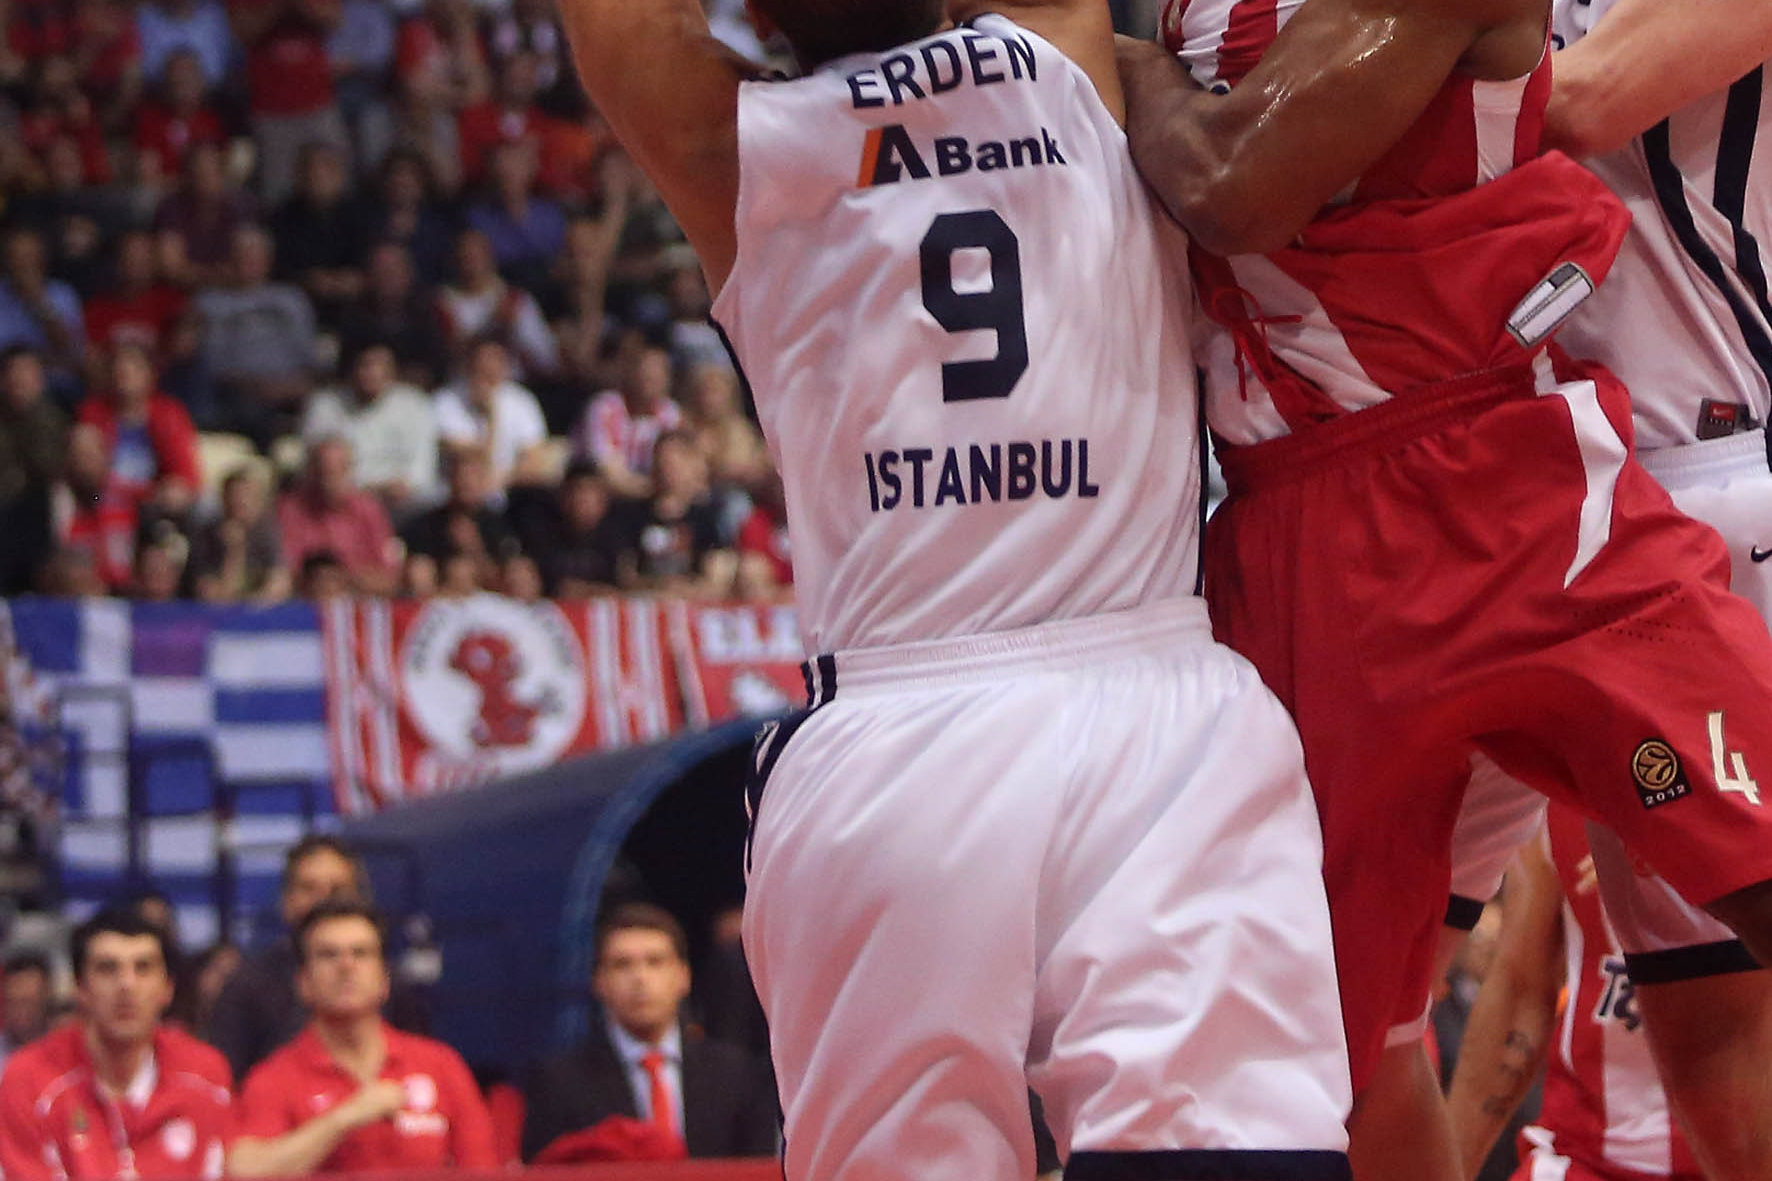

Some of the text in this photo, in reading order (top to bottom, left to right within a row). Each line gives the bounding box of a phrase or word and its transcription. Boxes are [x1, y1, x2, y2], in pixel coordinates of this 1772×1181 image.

[846, 33, 1038, 110] ERDEN
[919, 208, 1030, 404] 9
[864, 438, 1100, 513] ISTANBUL
[1645, 783, 1688, 808] 2012
[1706, 710, 1763, 805] 4
